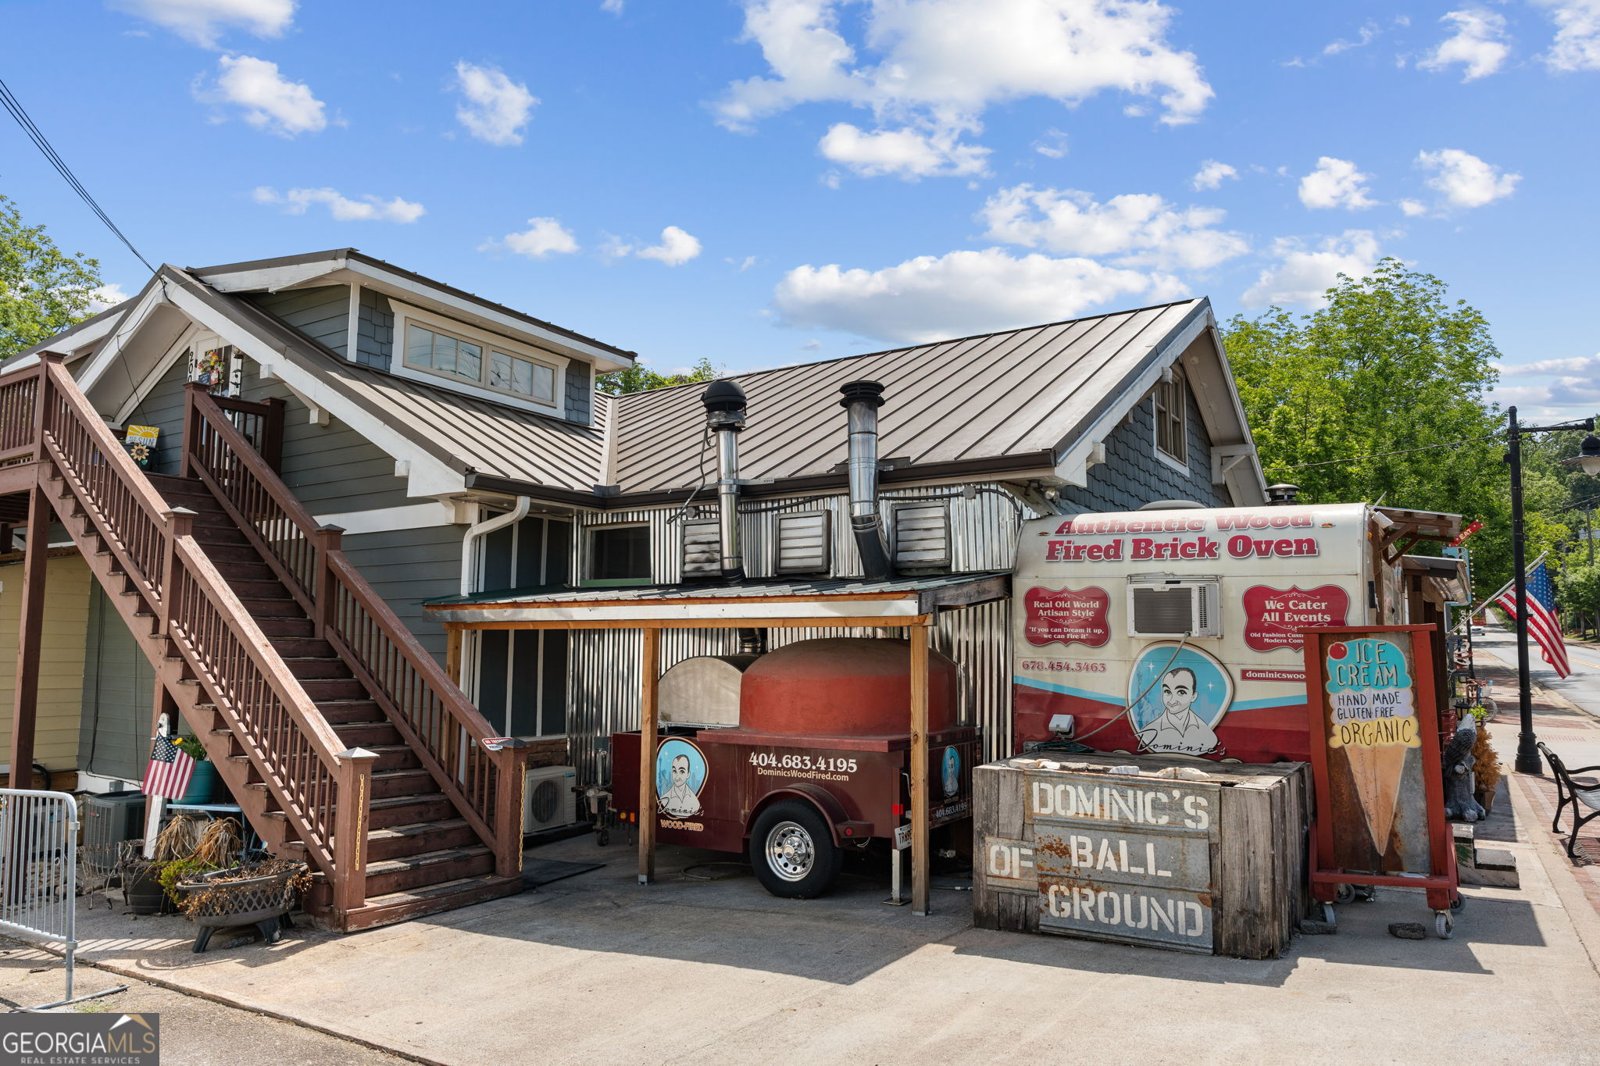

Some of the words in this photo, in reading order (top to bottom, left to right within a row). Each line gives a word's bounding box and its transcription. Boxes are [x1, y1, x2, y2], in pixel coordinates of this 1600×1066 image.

[1055, 517, 1206, 535] Authentic
[1215, 513, 1313, 531] Wood
[1459, 529, 1472, 540] EAT
[1045, 537, 1124, 562] Fired
[1130, 535, 1220, 561] Brick
[1226, 534, 1320, 559] Oven
[1033, 601, 1053, 609] Real
[1055, 601, 1071, 609] Old
[1073, 600, 1100, 609] World
[1264, 600, 1285, 610] We
[1288, 600, 1328, 610] Cater
[1037, 609, 1070, 617] Artisan
[1071, 609, 1095, 618] Style
[1261, 612, 1280, 622] All
[1284, 612, 1332, 622] Events
[1037, 627, 1049, 635] you
[1356, 641, 1389, 664] ICE
[1022, 660, 1107, 673] 678.454.3463
[1246, 671, 1306, 679] dominicswoo
[1336, 664, 1399, 687] CREAM
[1338, 694, 1368, 707] HAND
[1371, 691, 1402, 705] MADE
[1337, 706, 1372, 720] GLUTEN
[1374, 706, 1395, 719] FREE
[1340, 719, 1412, 746] ORGANIC
[1135, 728, 1226, 755] Dominic's
[748, 751, 858, 773] 404.683.4195
[757, 767, 849, 781] DominicsWoodFired.com
[657, 797, 704, 816] Dominic's
[1032, 781, 1209, 830] DOMINIC'S
[660, 819, 704, 832] WOOD-FIRED
[989, 845, 1034, 878] OF
[1070, 835, 1172, 878] BALL
[1048, 884, 1203, 937] GROUND
